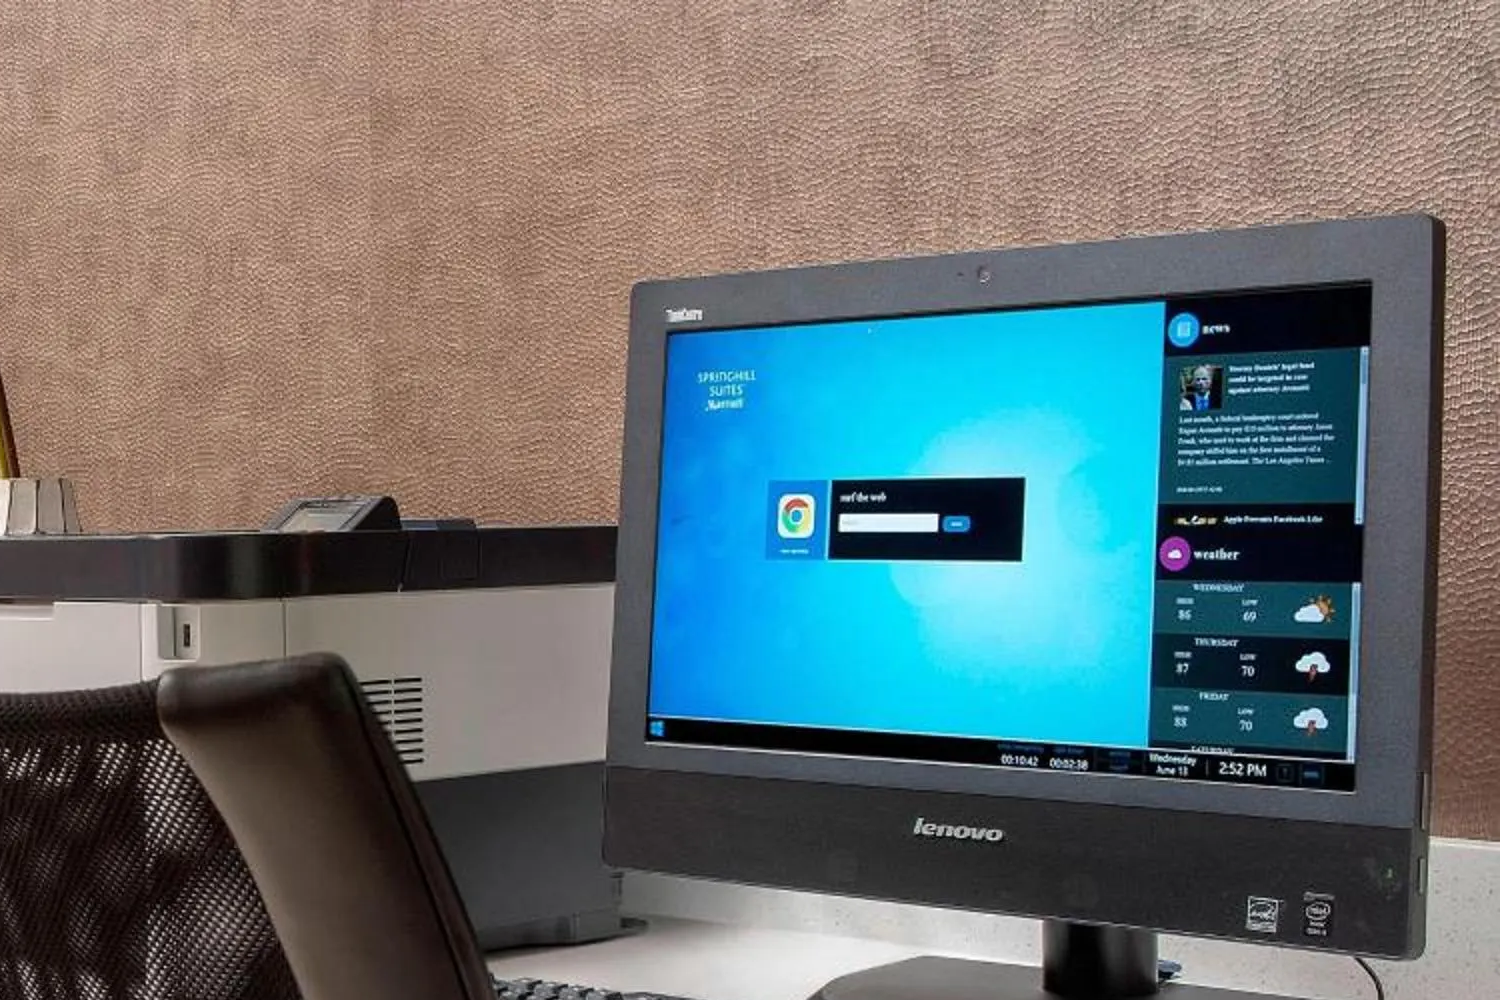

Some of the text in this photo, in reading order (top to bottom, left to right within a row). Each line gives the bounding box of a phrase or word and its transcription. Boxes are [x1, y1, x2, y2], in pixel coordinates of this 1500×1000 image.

[709, 384, 743, 397] SUITES
[1194, 549, 1240, 561] weather
[1243, 611, 1256, 622] 69
[1194, 637, 1240, 647] THURSDAY
[1241, 666, 1255, 677] 70
[1239, 720, 1252, 731] 70
[1150, 754, 1197, 767] Wednesday
[1219, 762, 1267, 777] 2:52 PM
[913, 817, 1004, 842] lenovo
